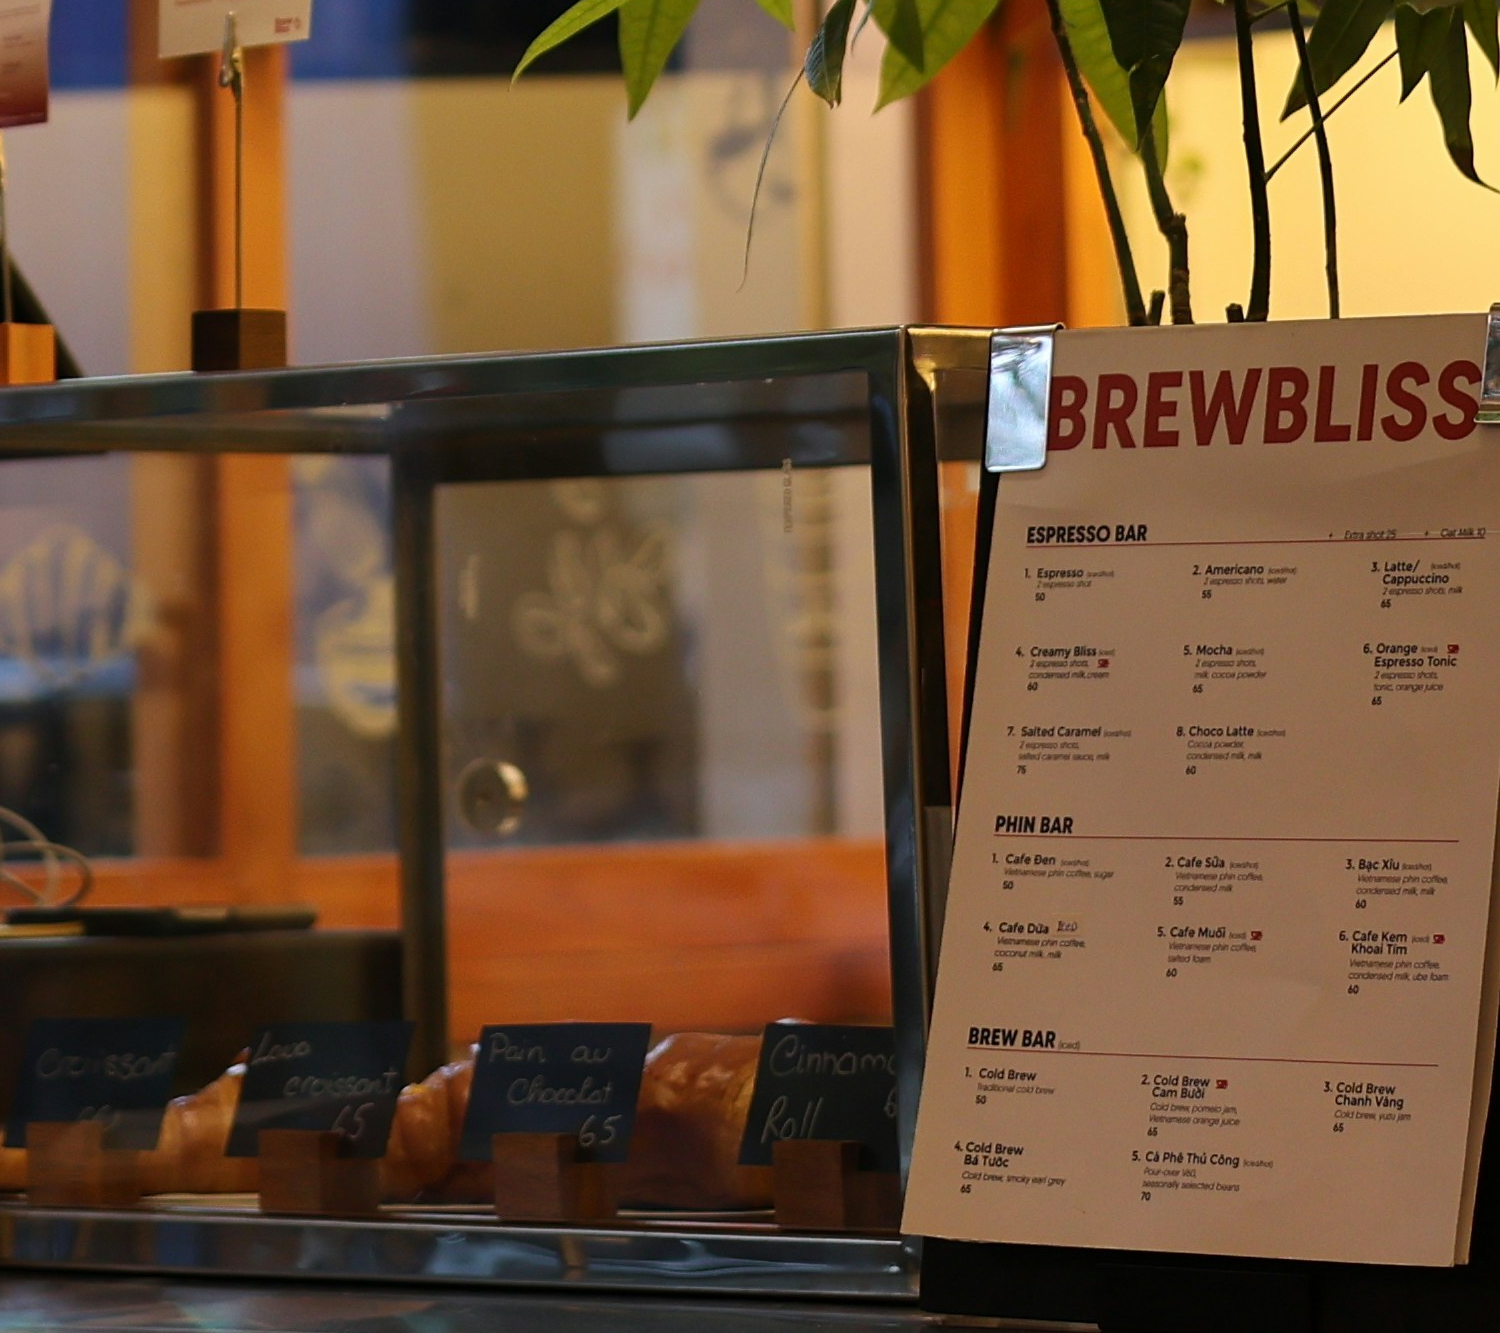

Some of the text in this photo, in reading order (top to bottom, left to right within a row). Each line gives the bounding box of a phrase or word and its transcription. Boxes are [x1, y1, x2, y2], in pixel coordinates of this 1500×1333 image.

[1046, 359, 1483, 451] BREWBLISS
[1027, 524, 1147, 544] ESPRESSO BAR
[1192, 564, 1264, 575] 2. Americano
[1371, 560, 1420, 572] 3. Latte/
[1037, 568, 1083, 581] Espresso
[1382, 573, 1449, 586] Cappuccino
[1035, 592, 1045, 601] 50
[1202, 590, 1212, 599] 55
[1380, 599, 1391, 608] 65
[1016, 645, 1097, 659] 4. Creamy Bliss
[1183, 645, 1233, 656] 5. Mocha
[1363, 643, 1418, 656] 6. Orange
[1374, 655, 1457, 669] Espresso Tonic
[1027, 682, 1038, 691] 60
[1192, 684, 1203, 693] 65
[1371, 696, 1382, 706] 65
[1021, 726, 1055, 737] Salted
[1057, 726, 1102, 737] Caramel
[1176, 726, 1254, 737] 8. Choco Latte
[1017, 765, 1027, 774] 75
[1185, 765, 1197, 775] 60
[995, 815, 1074, 834] PHIN BAR
[1005, 854, 1032, 865] Cafe
[1034, 854, 1056, 865] Đen
[1165, 857, 1175, 868] 2.
[1177, 857, 1203, 868] Cafe
[1345, 859, 1355, 870] 3.
[1358, 859, 1380, 872] Bạc
[1002, 881, 1013, 890] 50
[1173, 896, 1183, 906] 55
[1355, 899, 1366, 909] 60
[983, 922, 992, 932] 4.
[999, 922, 1025, 933] Cafe
[1157, 927, 1167, 937] 5.
[1169, 926, 1196, 938] Cafe
[1339, 931, 1408, 943] 6. Cafe Kem
[1351, 943, 1383, 955] Khoai
[992, 962, 1003, 972] 65
[1166, 968, 1177, 977] 60
[1347, 985, 1359, 995] 60
[968, 1027, 1018, 1047] BREW
[1022, 1030, 1056, 1048] BAR
[488, 1032, 611, 1063] Pain au
[979, 1068, 1005, 1080] Cold
[1008, 1069, 1037, 1082] Brew
[1141, 1075, 1210, 1088] 2. Cold Brew
[1152, 1087, 1178, 1099] Cam
[1323, 1082, 1395, 1095] 3. Cold Brew
[975, 1095, 986, 1105] 50
[1335, 1095, 1371, 1107] Chanh
[760, 1095, 824, 1144] Roll
[579, 1114, 623, 1148] 65
[1147, 1127, 1158, 1137] 65
[1333, 1123, 1344, 1132] 65
[954, 1141, 1024, 1156] 4. Cold Brew
[964, 1154, 979, 1166] Bá
[1131, 1151, 1141, 1162] 5.
[1145, 1150, 1160, 1163] Cà
[1162, 1151, 1184, 1164] Phê
[1210, 1153, 1240, 1168] Công
[960, 1184, 972, 1194] 65
[1141, 1192, 1151, 1201] 70
